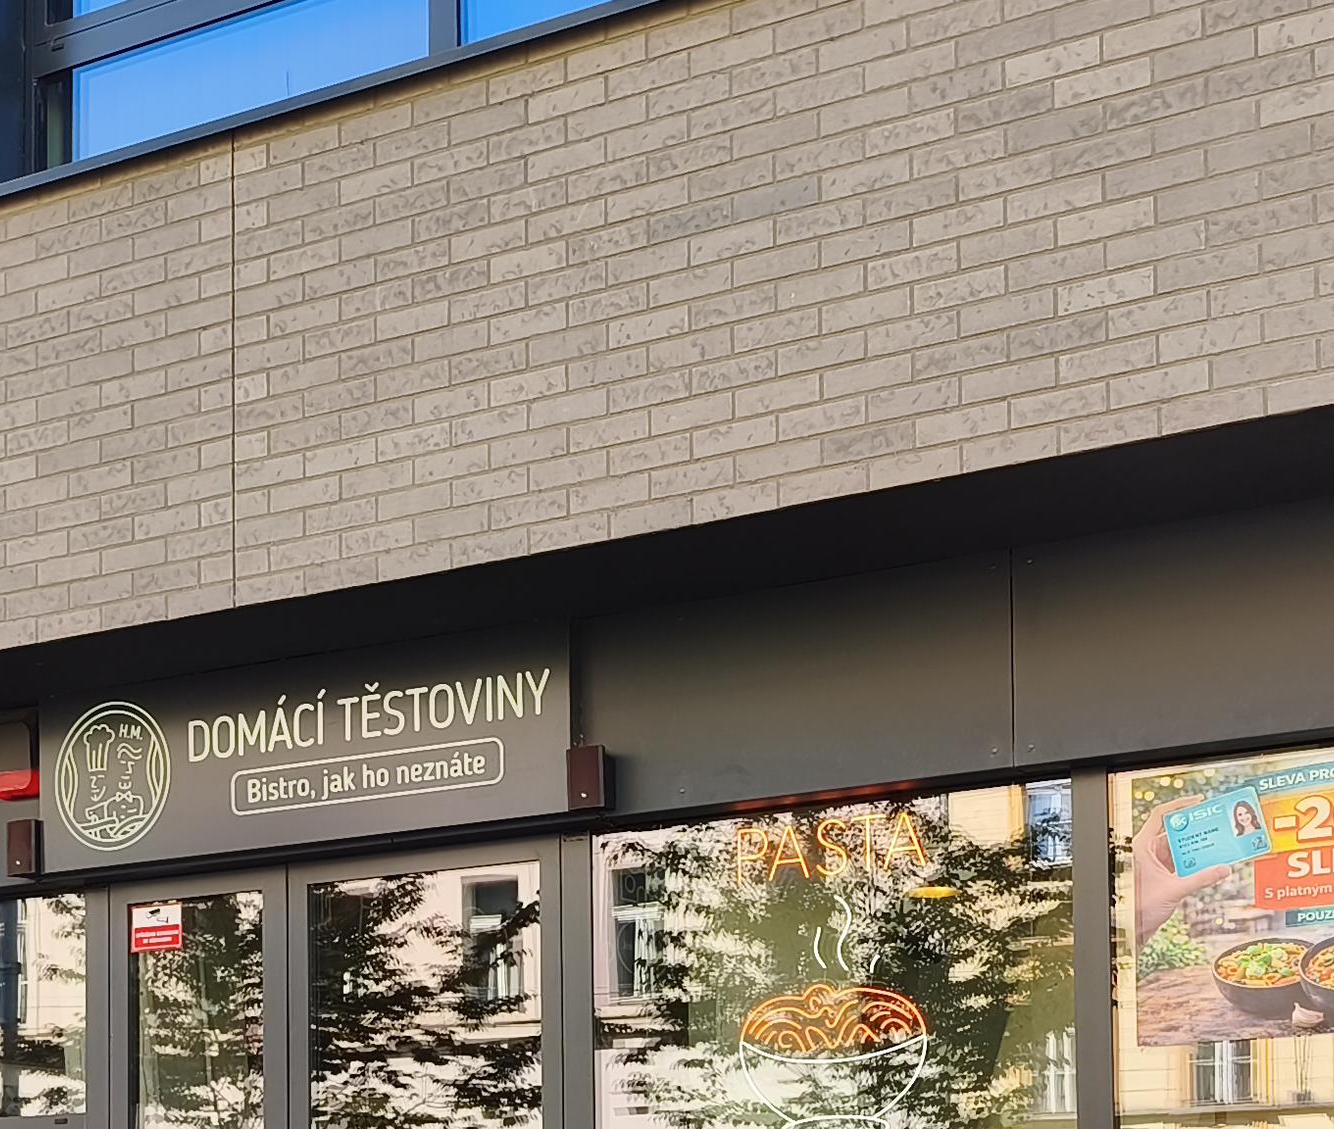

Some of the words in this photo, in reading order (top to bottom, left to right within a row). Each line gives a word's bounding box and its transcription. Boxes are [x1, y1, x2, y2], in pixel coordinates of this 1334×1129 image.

[118, 723, 143, 740] H.M.
[187, 688, 327, 763] DOMÁCÍ
[337, 667, 551, 742] TĚSTOVINY
[246, 778, 317, 803] Bistro,
[322, 766, 356, 800] jak
[362, 765, 390, 790] ho
[396, 751, 487, 784] neznáte
[1258, 773, 1306, 792] SLEVA
[737, 811, 928, 886] PASTA
[1264, 887, 1274, 899] S
[1277, 880, 1333, 901] platným
